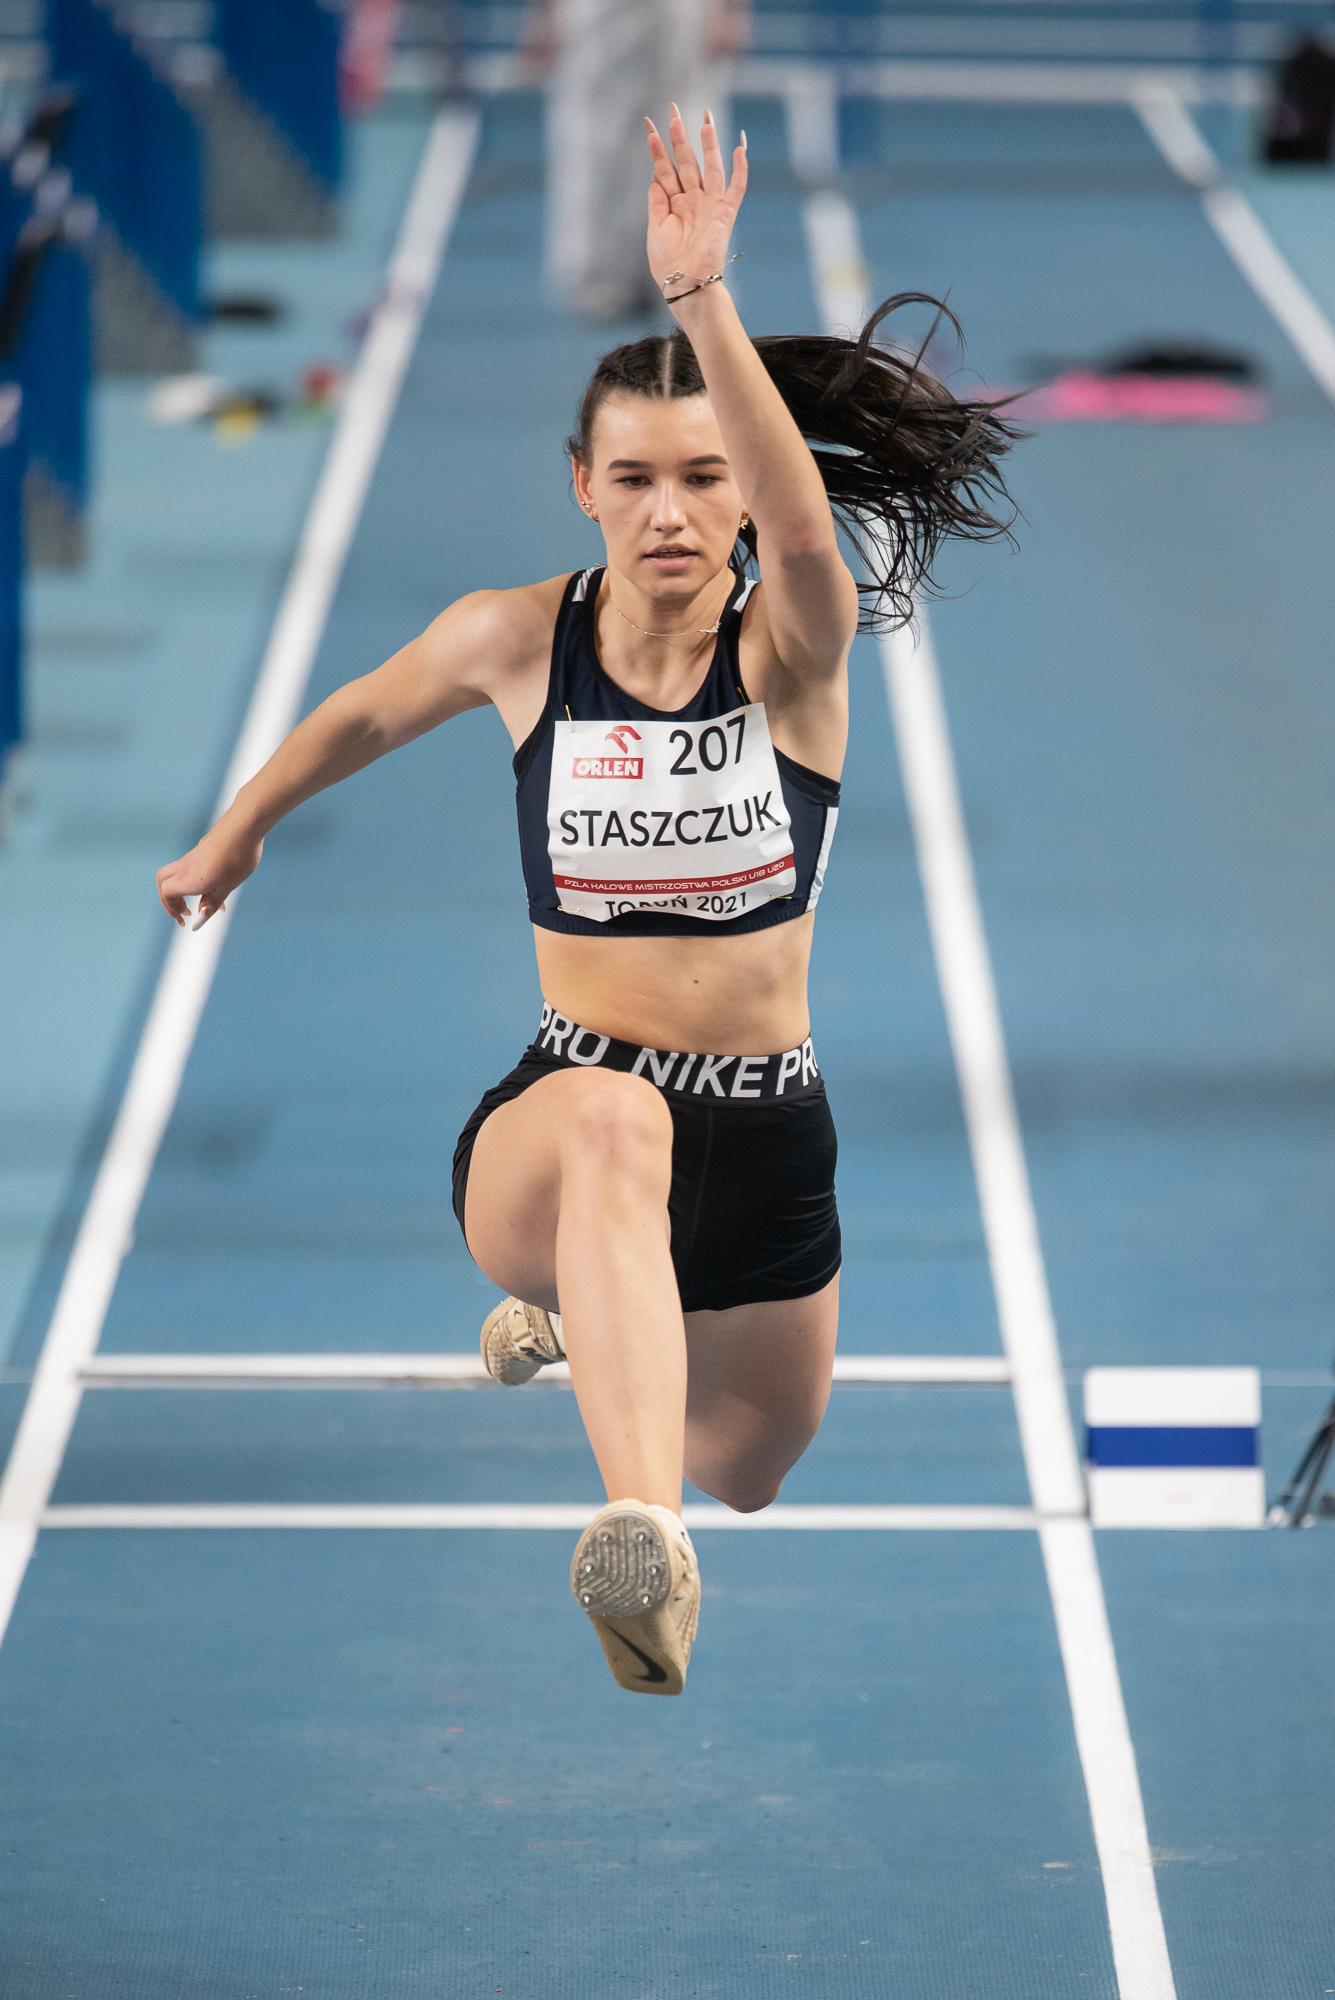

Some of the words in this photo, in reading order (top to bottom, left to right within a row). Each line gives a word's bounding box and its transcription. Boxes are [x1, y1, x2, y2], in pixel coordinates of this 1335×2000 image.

[669, 713, 747, 776] 207
[575, 759, 640, 778] ORLEN
[559, 790, 782, 847] STASZCZUK
[564, 879, 590, 890] PZLA
[590, 882, 634, 891] HALOWE
[634, 881, 710, 892] MISTRZOSTWA
[711, 874, 748, 888] POLSKI
[748, 869, 766, 880] U18
[767, 861, 785, 874] U20
[696, 891, 747, 914] 2021
[540, 1000, 611, 1066] PRO
[630, 1047, 769, 1098] NIKE
[775, 1036, 820, 1096] PR
